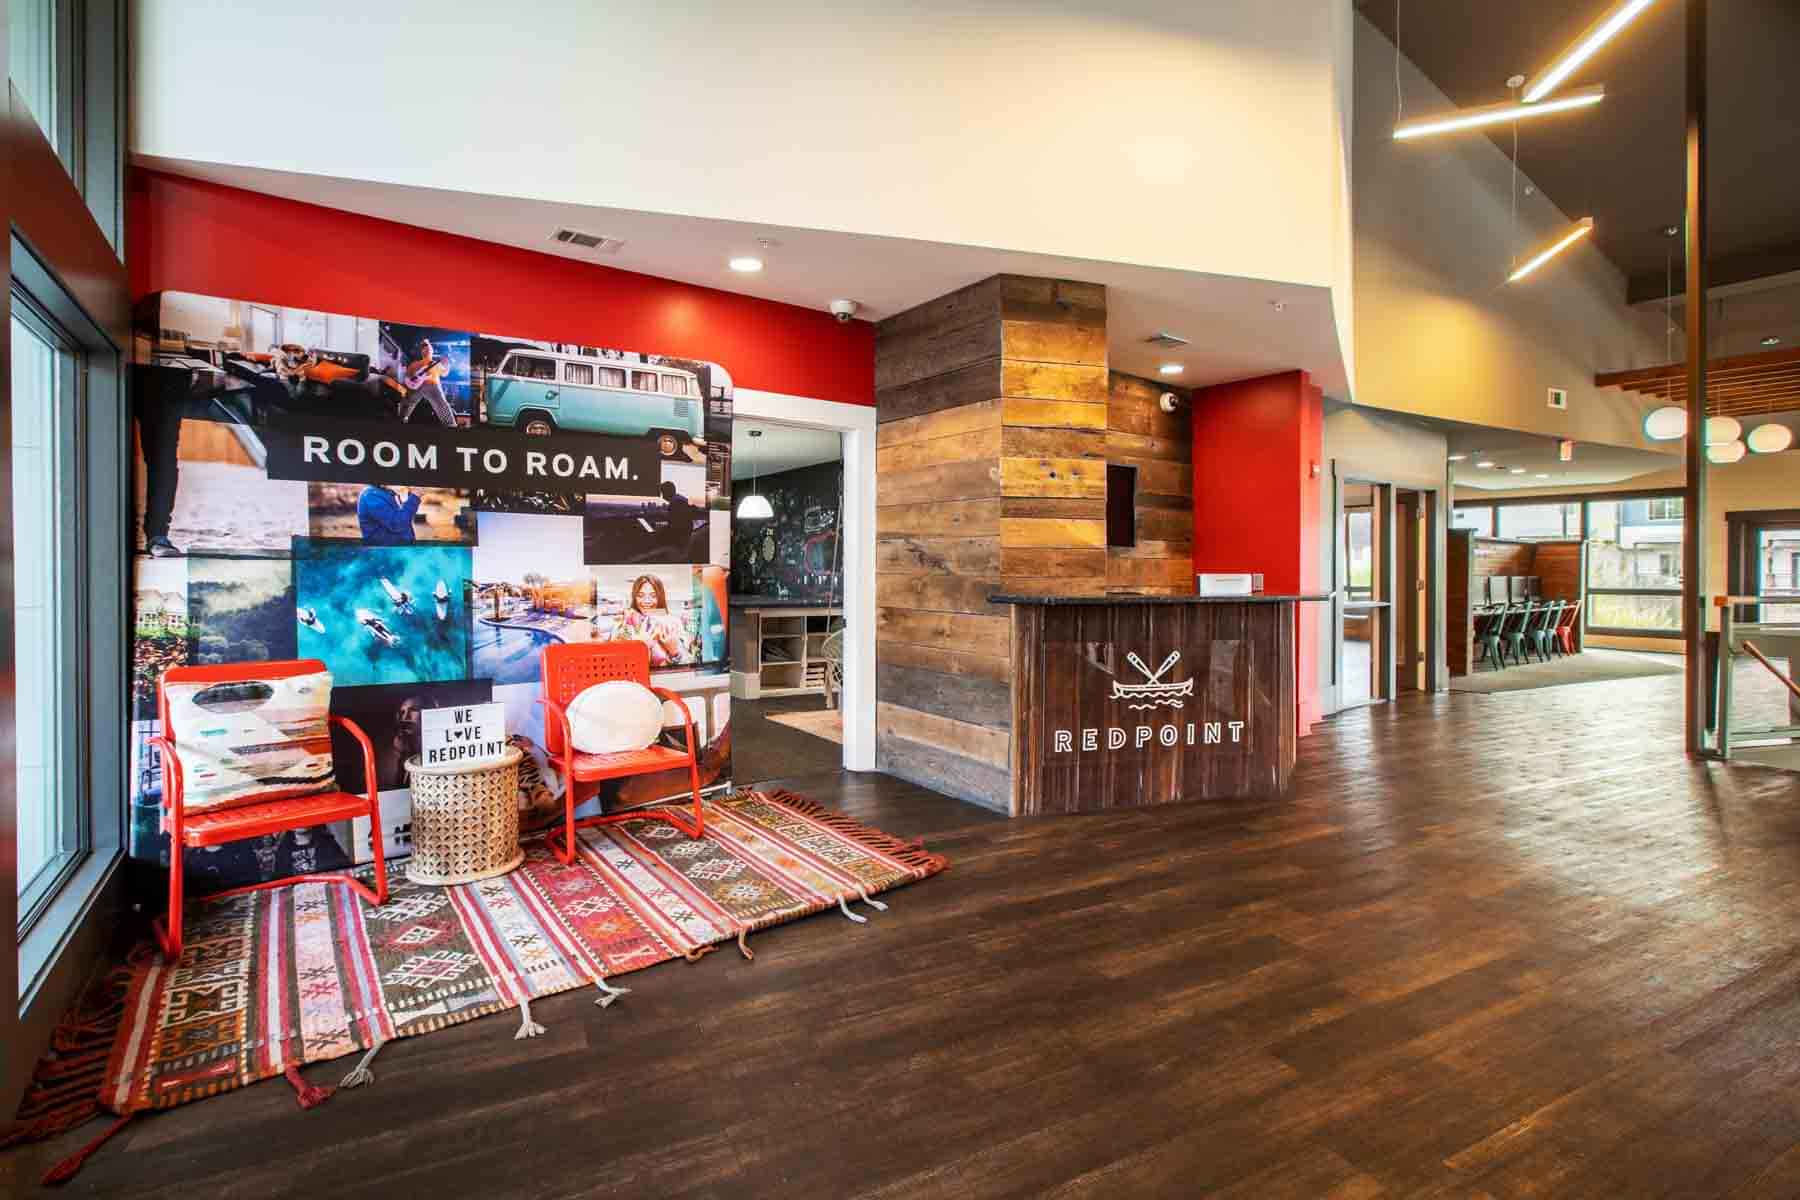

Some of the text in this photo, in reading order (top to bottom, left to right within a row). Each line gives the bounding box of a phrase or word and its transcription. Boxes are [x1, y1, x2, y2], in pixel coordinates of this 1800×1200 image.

[302, 435, 639, 481] ROOM TO ROAM.
[454, 709, 473, 724] WE
[1054, 720, 1245, 753] REDPOINT
[428, 741, 504, 763] REDPOINT
